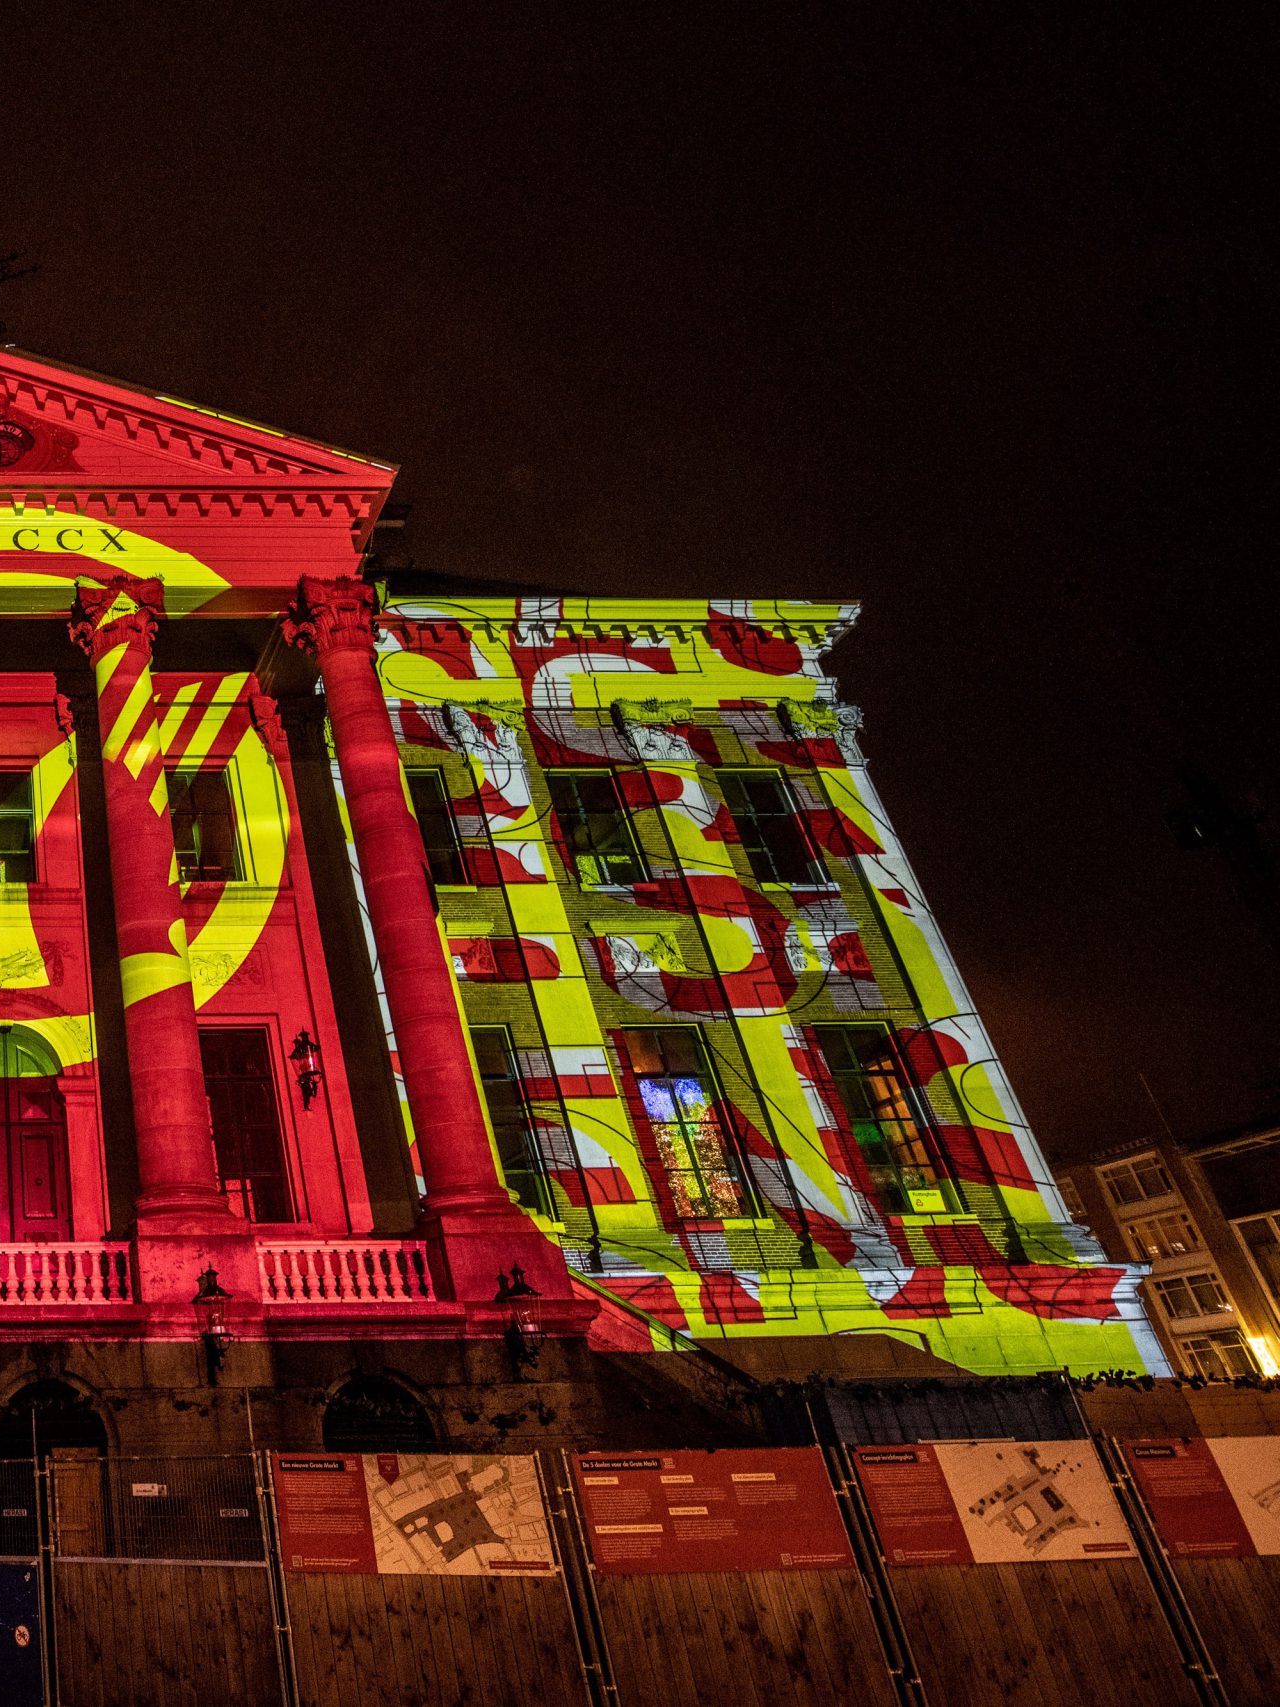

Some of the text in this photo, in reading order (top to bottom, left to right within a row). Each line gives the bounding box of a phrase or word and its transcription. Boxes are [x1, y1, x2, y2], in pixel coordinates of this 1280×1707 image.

[281, 1461, 291, 1469] Een
[291, 1461, 309, 1469] nieuwe
[309, 1461, 323, 1469] Grote
[323, 1461, 339, 1469] Markt
